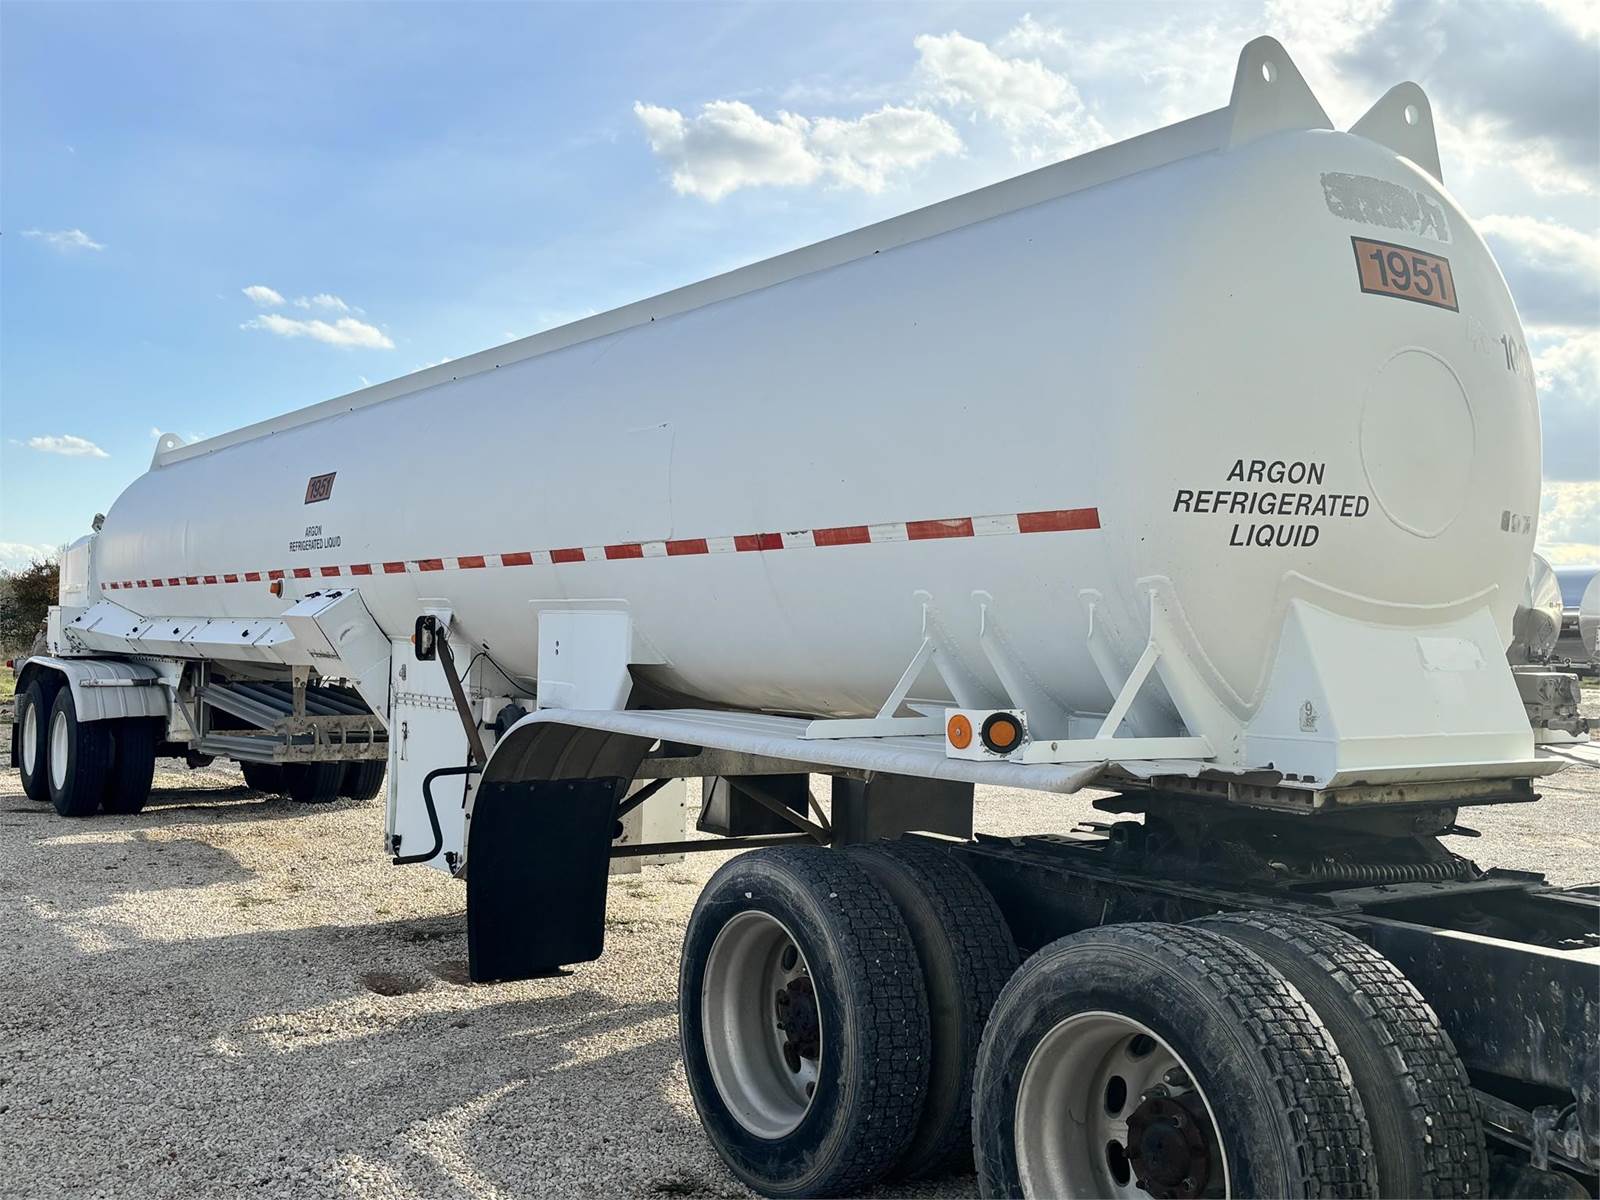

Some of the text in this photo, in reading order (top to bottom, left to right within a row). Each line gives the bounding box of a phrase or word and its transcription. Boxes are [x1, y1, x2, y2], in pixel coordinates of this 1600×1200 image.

[1369, 249, 1447, 300] 1951
[1226, 459, 1325, 485] ARGON
[310, 476, 332, 499] 1951
[1172, 489, 1370, 518] REFRIGERATED
[305, 525, 322, 537] ARGON
[1229, 524, 1320, 547] LIQUID
[289, 536, 342, 552] REFRIGERATED LIQUID
